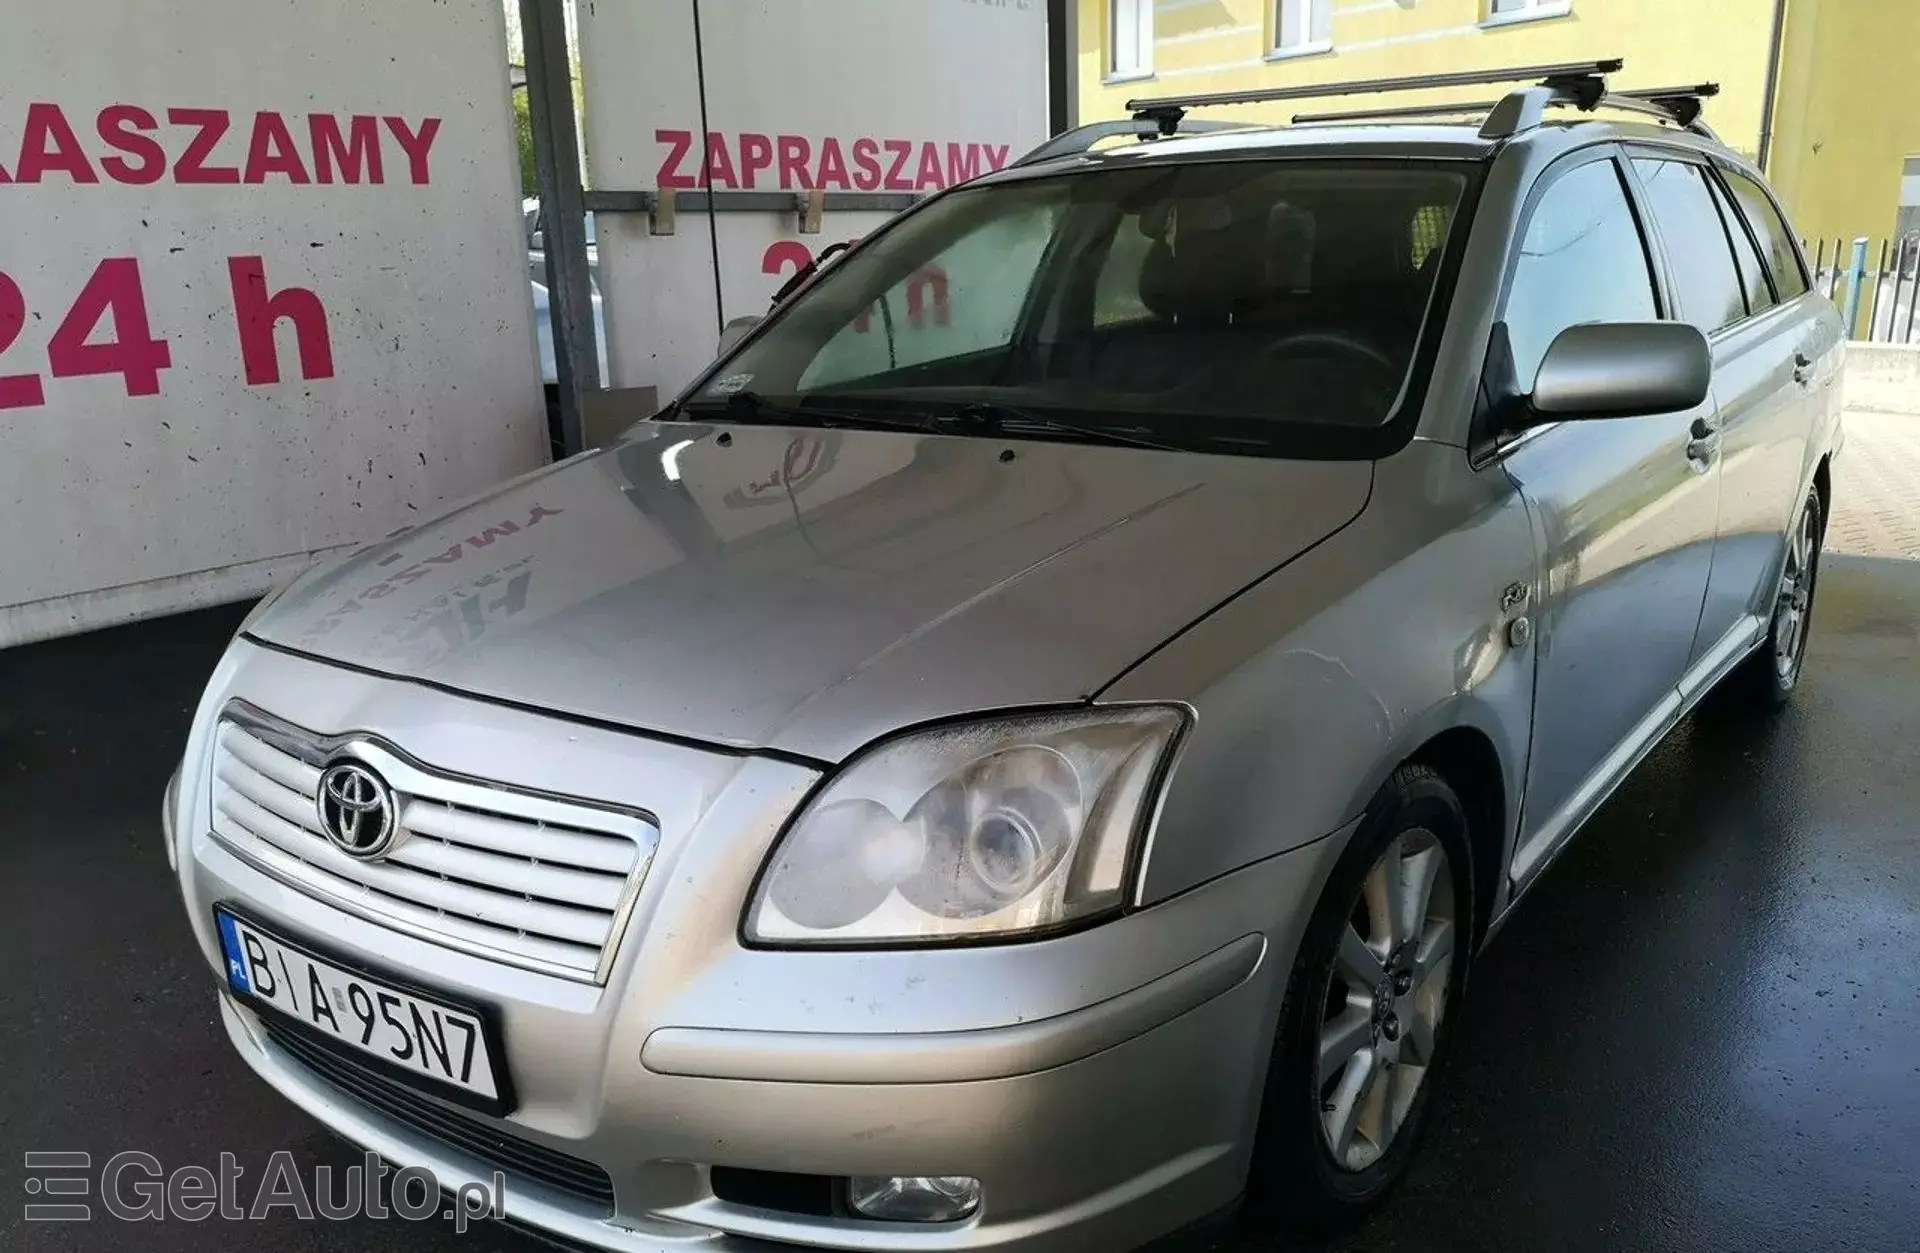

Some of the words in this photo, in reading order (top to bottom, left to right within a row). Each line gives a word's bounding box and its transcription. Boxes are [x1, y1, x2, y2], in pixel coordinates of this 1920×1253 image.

[0, 103, 442, 185] ASZAMY
[228, 256, 334, 385] h
[230, 958, 246, 980] PL
[242, 930, 340, 1033] BIA
[348, 982, 476, 1084] 95N7
